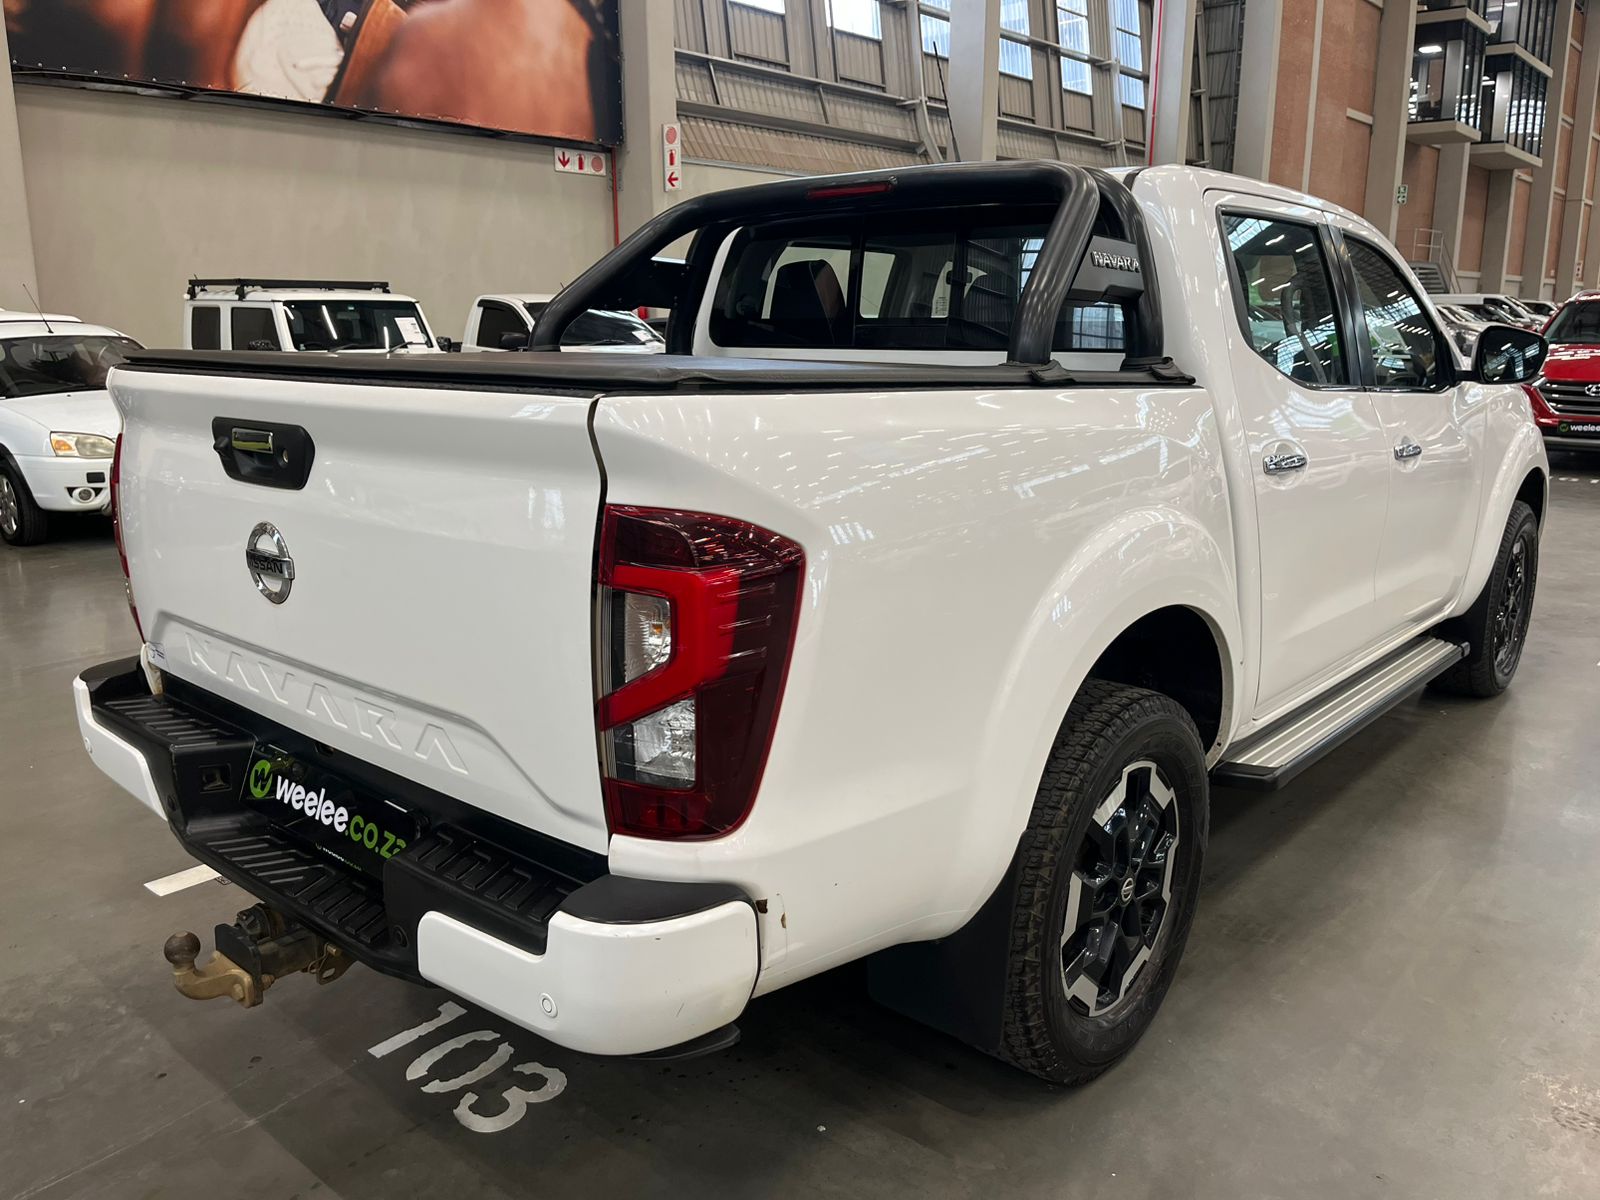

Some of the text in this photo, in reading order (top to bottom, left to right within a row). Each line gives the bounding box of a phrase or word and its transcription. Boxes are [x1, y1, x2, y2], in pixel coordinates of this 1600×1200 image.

[1091, 251, 1140, 273] NAVARA
[185, 632, 469, 775] NAVARA
[367, 1000, 568, 1133] 103
